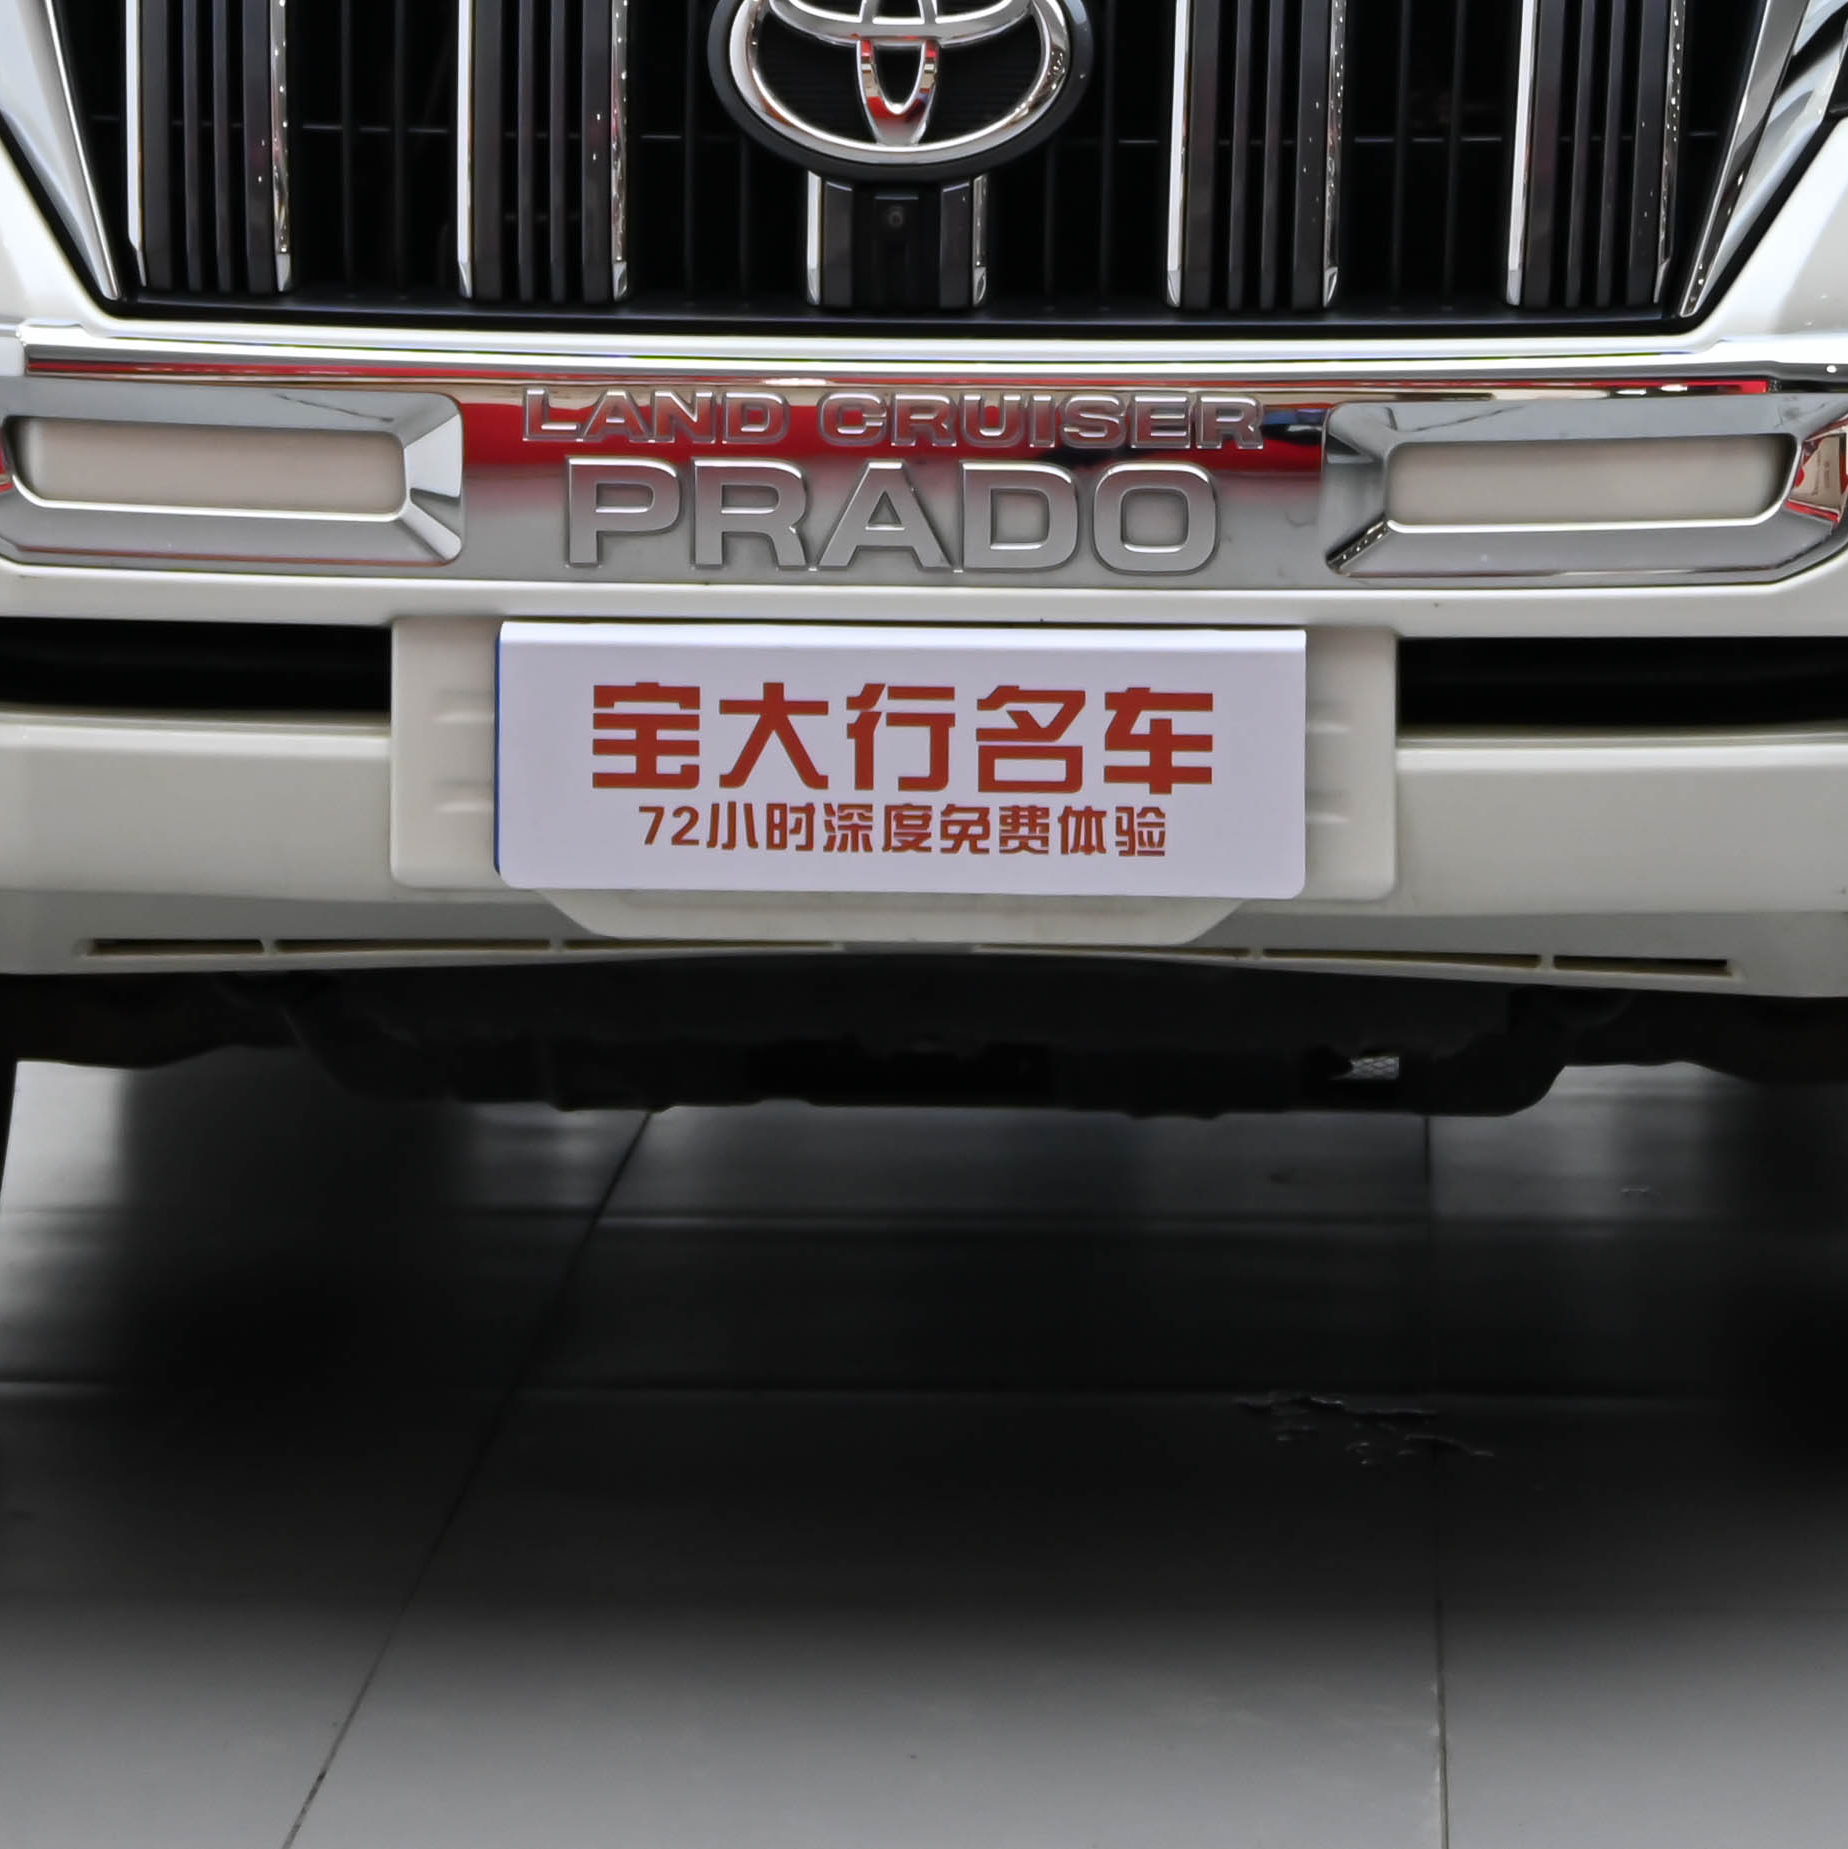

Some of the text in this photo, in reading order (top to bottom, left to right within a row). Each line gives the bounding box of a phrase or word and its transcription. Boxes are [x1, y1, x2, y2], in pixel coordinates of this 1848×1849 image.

[522, 388, 1265, 450] LAND CRUISER
[565, 455, 1220, 576] PRADO
[592, 681, 1215, 795] 宝大行名车
[638, 801, 1167, 856] 72小时深度免费体验
